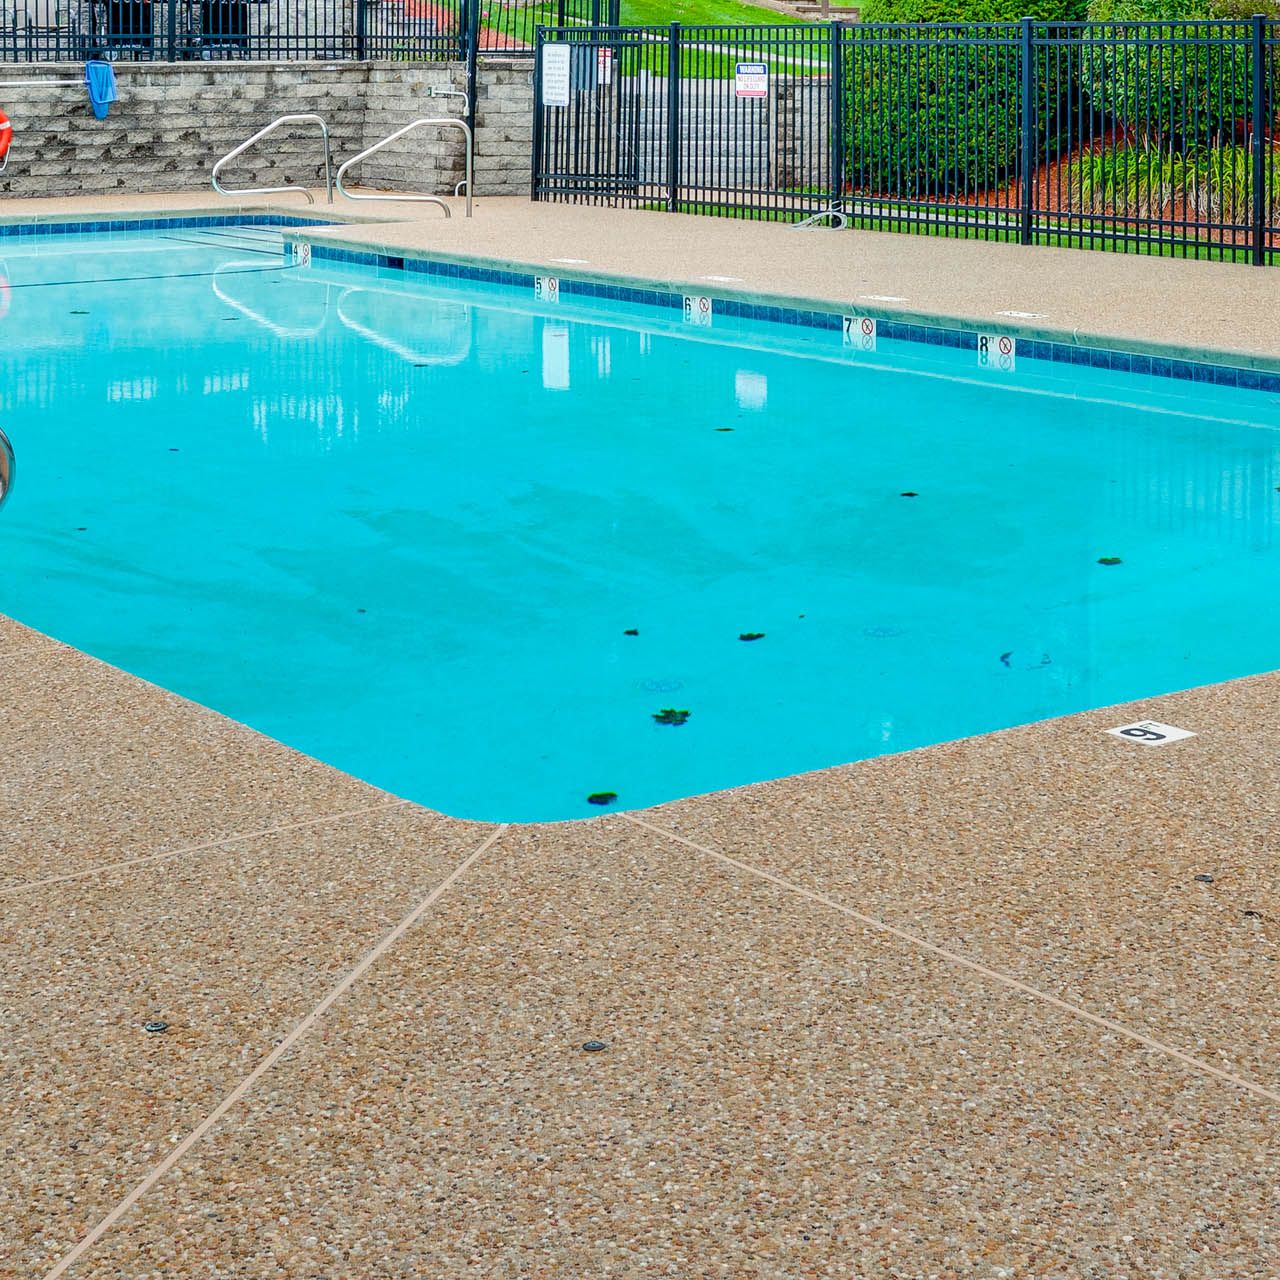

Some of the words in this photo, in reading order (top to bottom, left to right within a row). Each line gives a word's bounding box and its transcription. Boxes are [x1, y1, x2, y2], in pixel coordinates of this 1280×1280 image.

[293, 244, 298, 256] 4
[536, 277, 542, 290] 5
[684, 296, 691, 311] 6
[844, 317, 852, 333] 7
[980, 335, 989, 352] 8
[1120, 728, 1167, 741] 9
